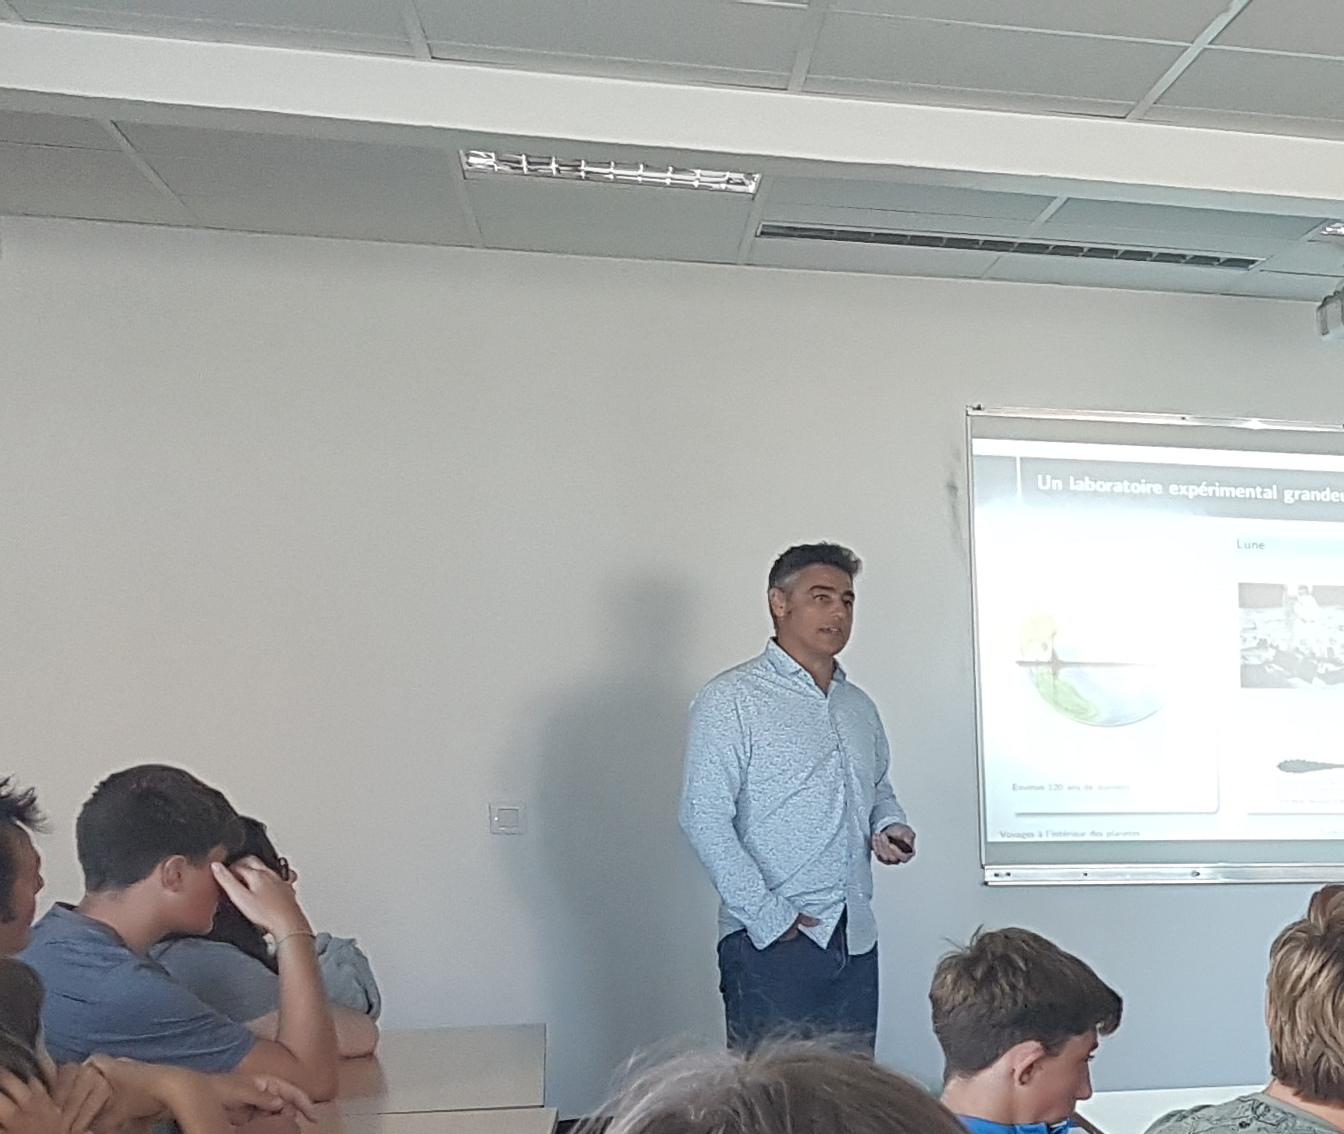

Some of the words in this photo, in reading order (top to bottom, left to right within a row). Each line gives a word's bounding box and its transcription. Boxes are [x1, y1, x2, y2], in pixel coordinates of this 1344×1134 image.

[1037, 474, 1062, 491] Un
[1069, 475, 1163, 495] laboratoire
[1169, 481, 1277, 500] expérimental
[1236, 539, 1265, 550] Lune
